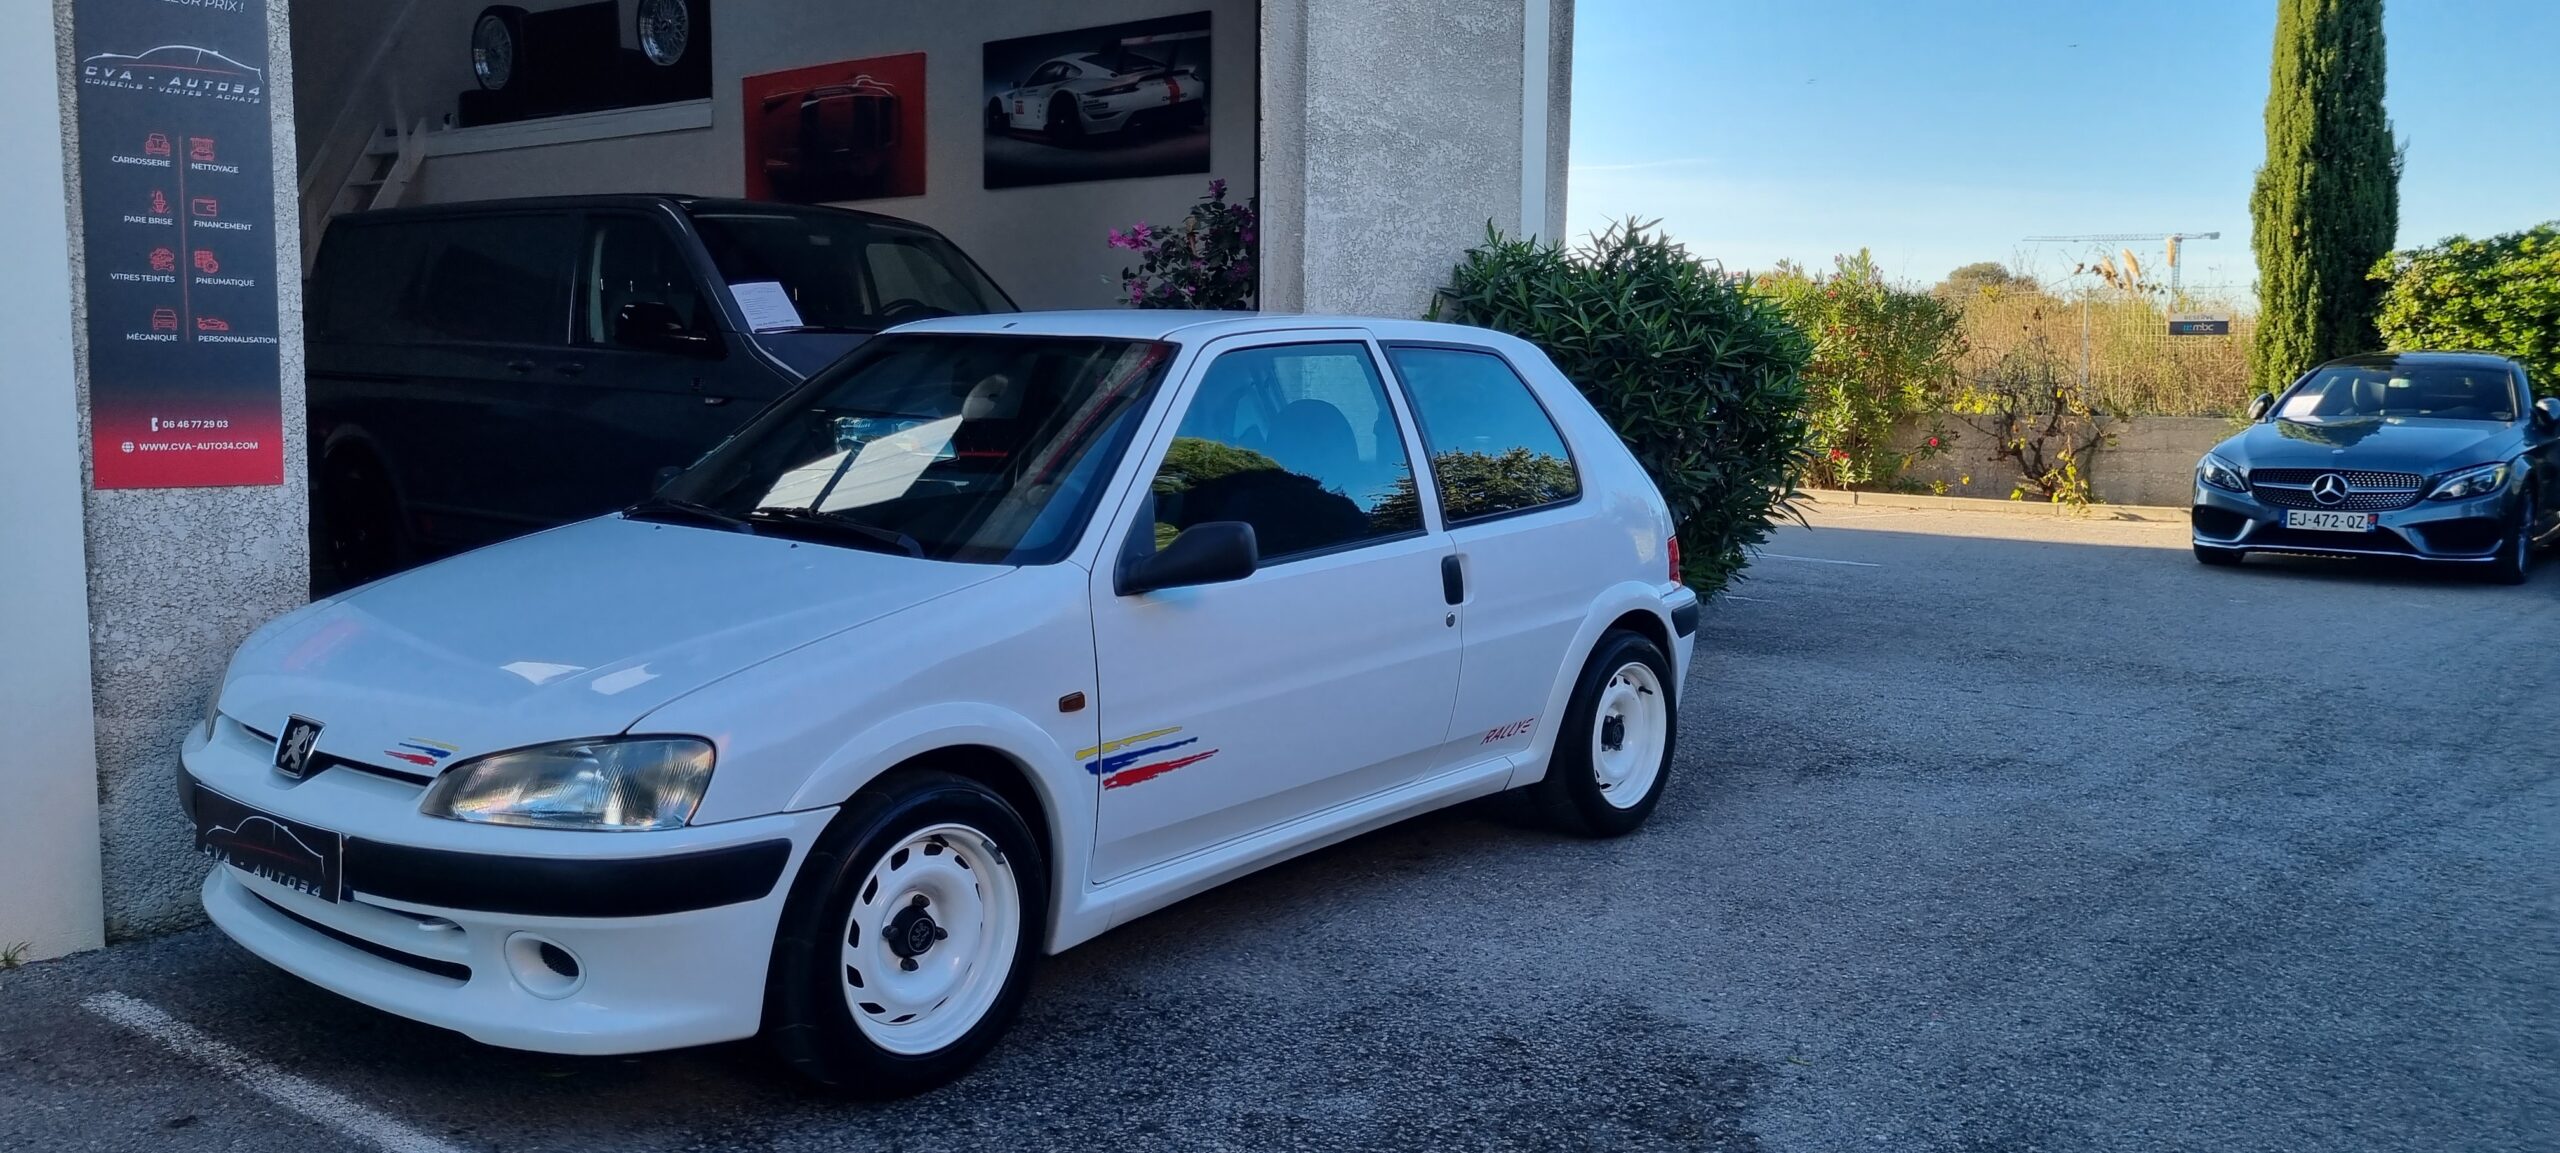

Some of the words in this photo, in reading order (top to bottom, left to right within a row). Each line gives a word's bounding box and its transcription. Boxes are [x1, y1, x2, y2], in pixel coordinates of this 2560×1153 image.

[84, 66, 133, 80] CVA
[169, 76, 261, 96] AUTO34
[84, 77, 144, 90] CONSEILS
[159, 86, 202, 97] VENTES
[215, 93, 261, 104] ACHATS
[111, 155, 171, 168] CARROSSERIE
[191, 163, 239, 174] NETTOYAGE
[124, 215, 147, 225] PARE
[148, 217, 173, 226] BRISE
[193, 220, 252, 231] FINANCEMENT
[110, 272, 141, 282] VITRES
[195, 276, 255, 287] PNEUMATIQUE
[126, 332, 178, 342] MÉCANIQUE
[198, 335, 278, 344] PERSONNALISATION
[162, 420, 176, 429] 06
[177, 420, 190, 429] 46
[191, 420, 202, 429] 77
[203, 420, 216, 429] 29
[216, 420, 229, 429] 03
[139, 441, 259, 451] WWW.CVA-AUTO34.COM
[2289, 512, 2365, 529] EJ-472-QZ
[1480, 717, 1535, 746] RALLYE
[204, 843, 231, 866] CVA
[252, 864, 322, 898] AUTO34
